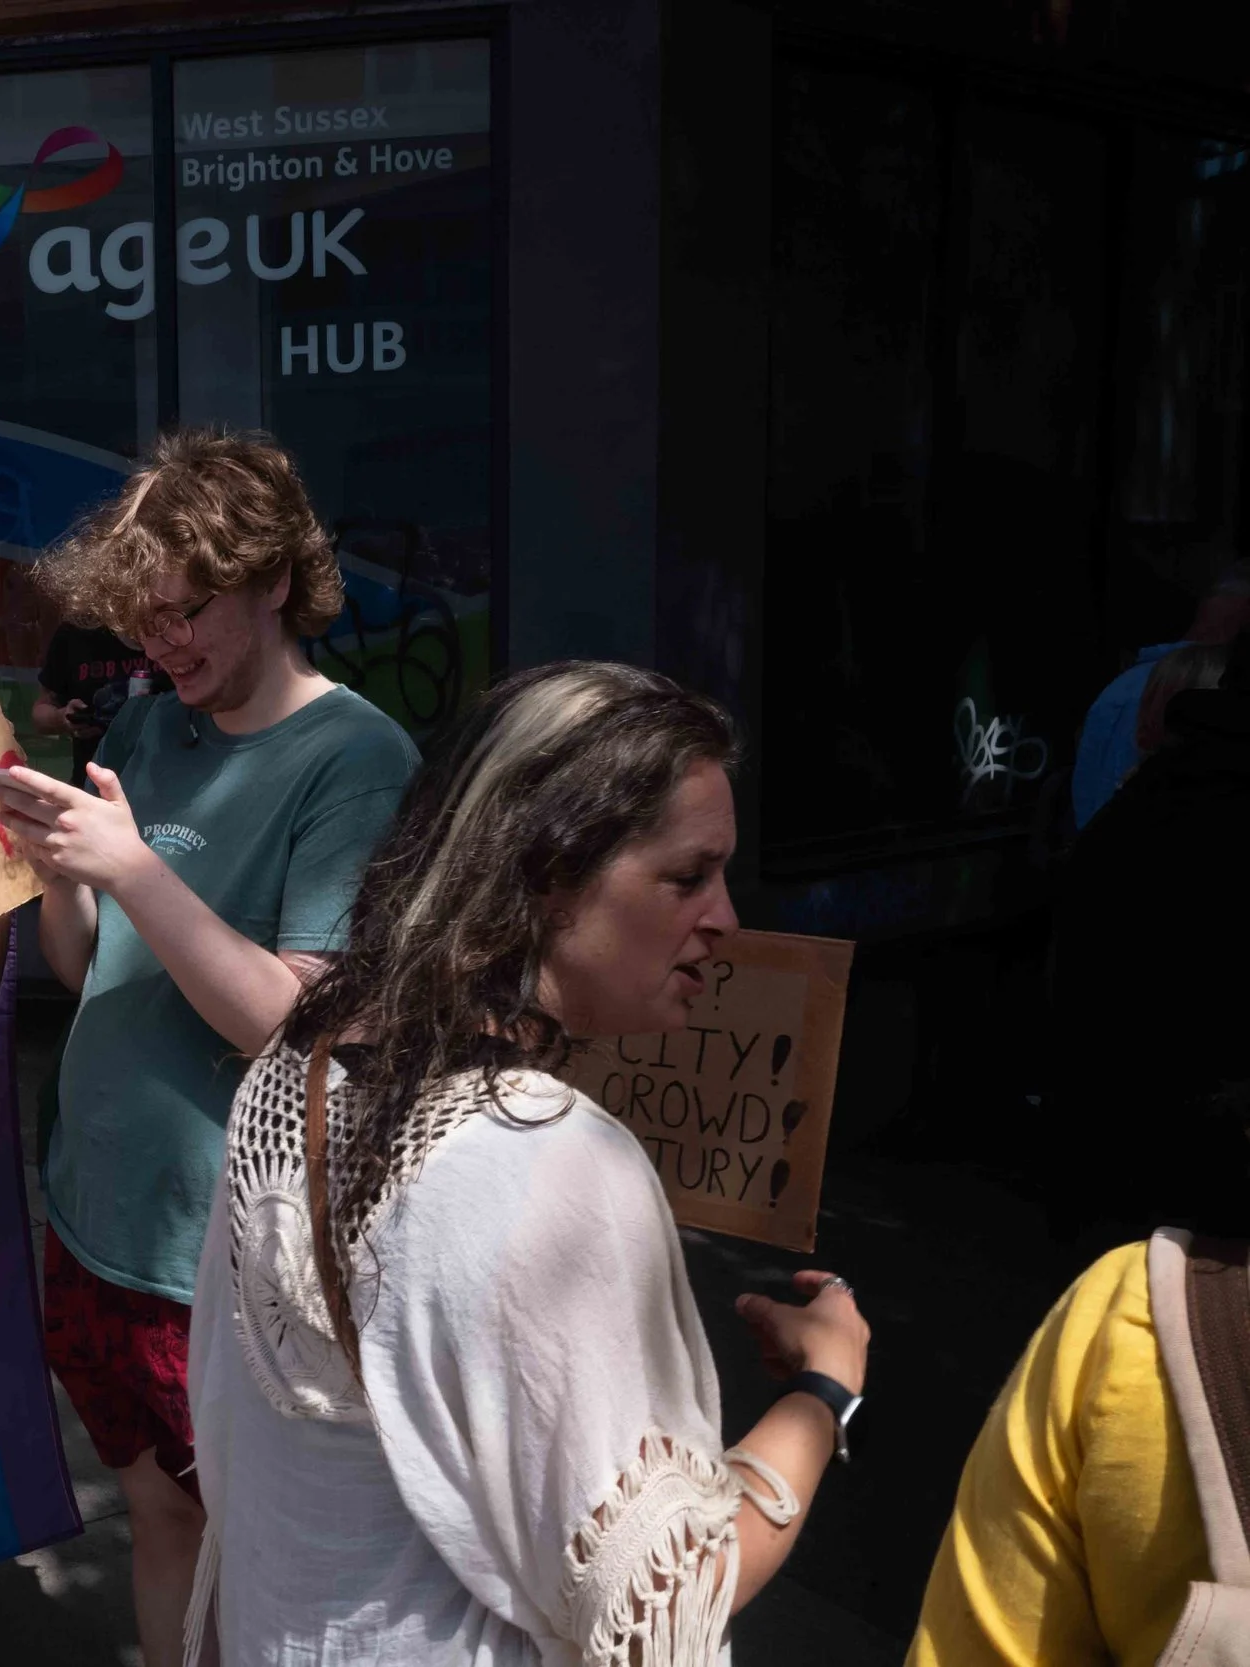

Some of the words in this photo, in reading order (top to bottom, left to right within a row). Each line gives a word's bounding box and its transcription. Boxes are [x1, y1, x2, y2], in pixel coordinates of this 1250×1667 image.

[182, 109, 264, 140] West
[275, 105, 389, 135] Sussex
[182, 151, 323, 192] Brighton
[334, 146, 359, 176] &
[370, 144, 454, 173] Hove
[280, 321, 407, 376] HUB
[143, 823, 208, 851] PROPHECY
[638, 1135, 790, 1208] TURY!
